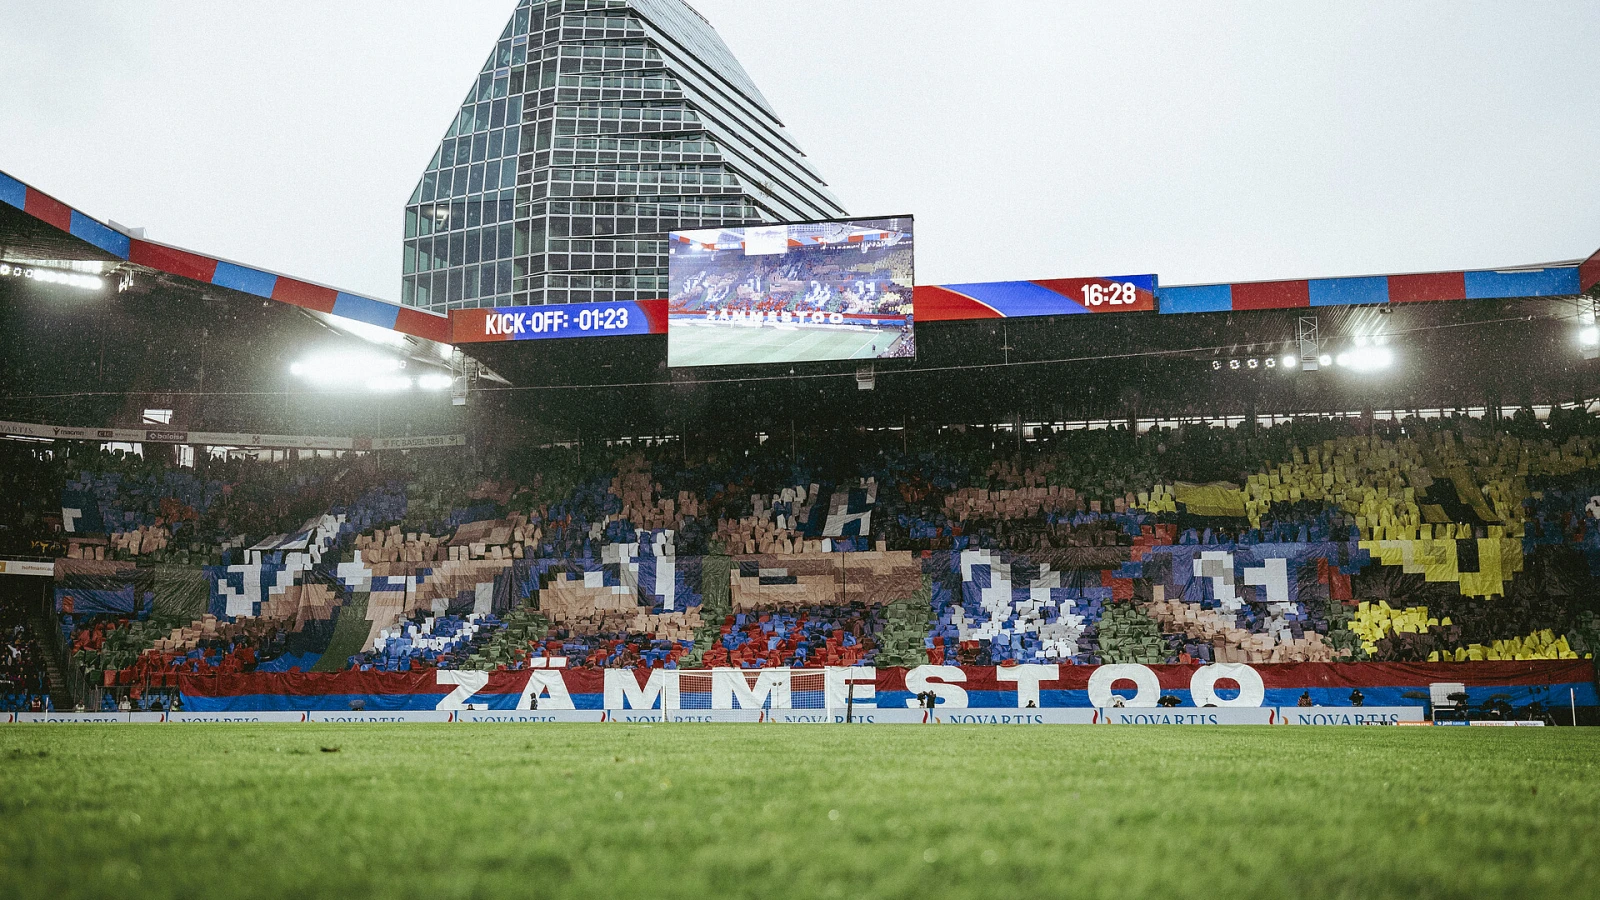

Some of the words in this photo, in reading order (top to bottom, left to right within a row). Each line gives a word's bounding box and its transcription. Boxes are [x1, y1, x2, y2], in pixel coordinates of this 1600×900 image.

[1081, 282, 1136, 306] 16:28
[485, 311, 568, 335] KICK-OFF:
[573, 307, 628, 331] -01:23
[390, 439, 400, 447] FC
[401, 438, 426, 447] BASEL
[949, 714, 1043, 724] NOVARTIS
[1120, 714, 1218, 725] NOVARTIS
[1298, 713, 1399, 725] NOVARTIS
